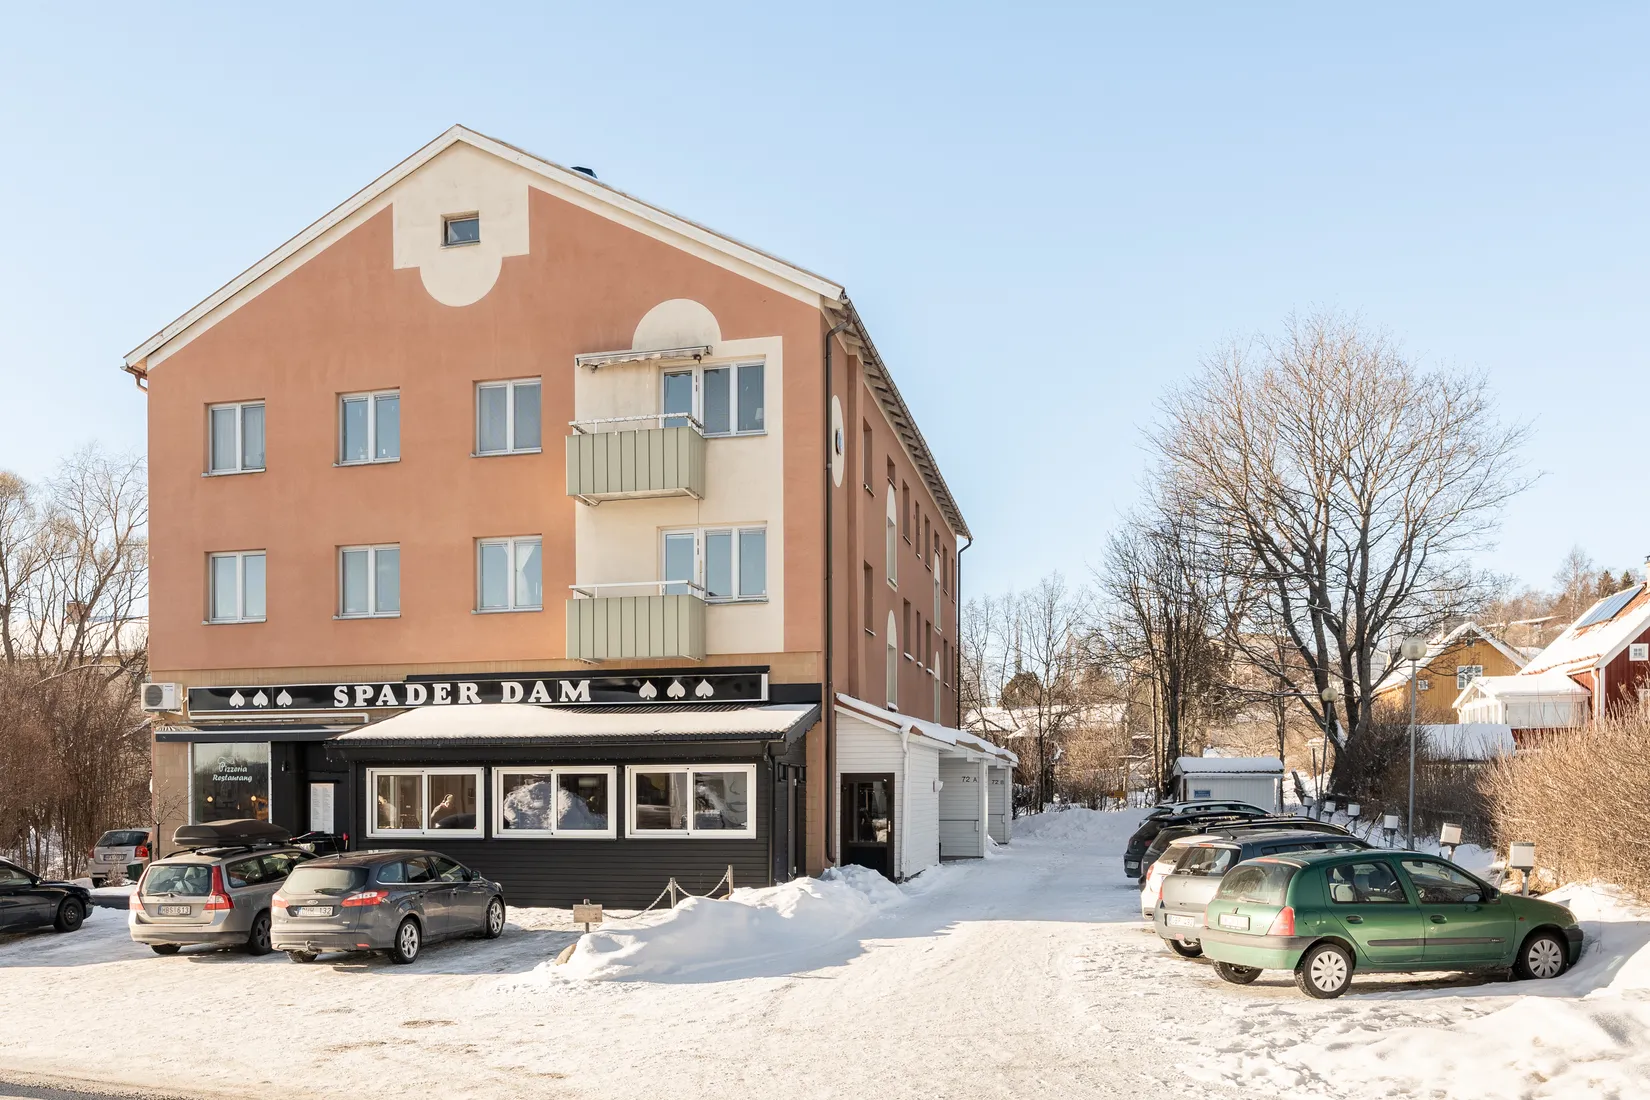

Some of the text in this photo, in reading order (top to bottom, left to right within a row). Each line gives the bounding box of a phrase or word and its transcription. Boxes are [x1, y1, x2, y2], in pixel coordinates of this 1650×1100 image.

[333, 680, 592, 707] SPADER DAM
[218, 759, 248, 773] Pizzeria
[212, 773, 253, 783] Restaurang
